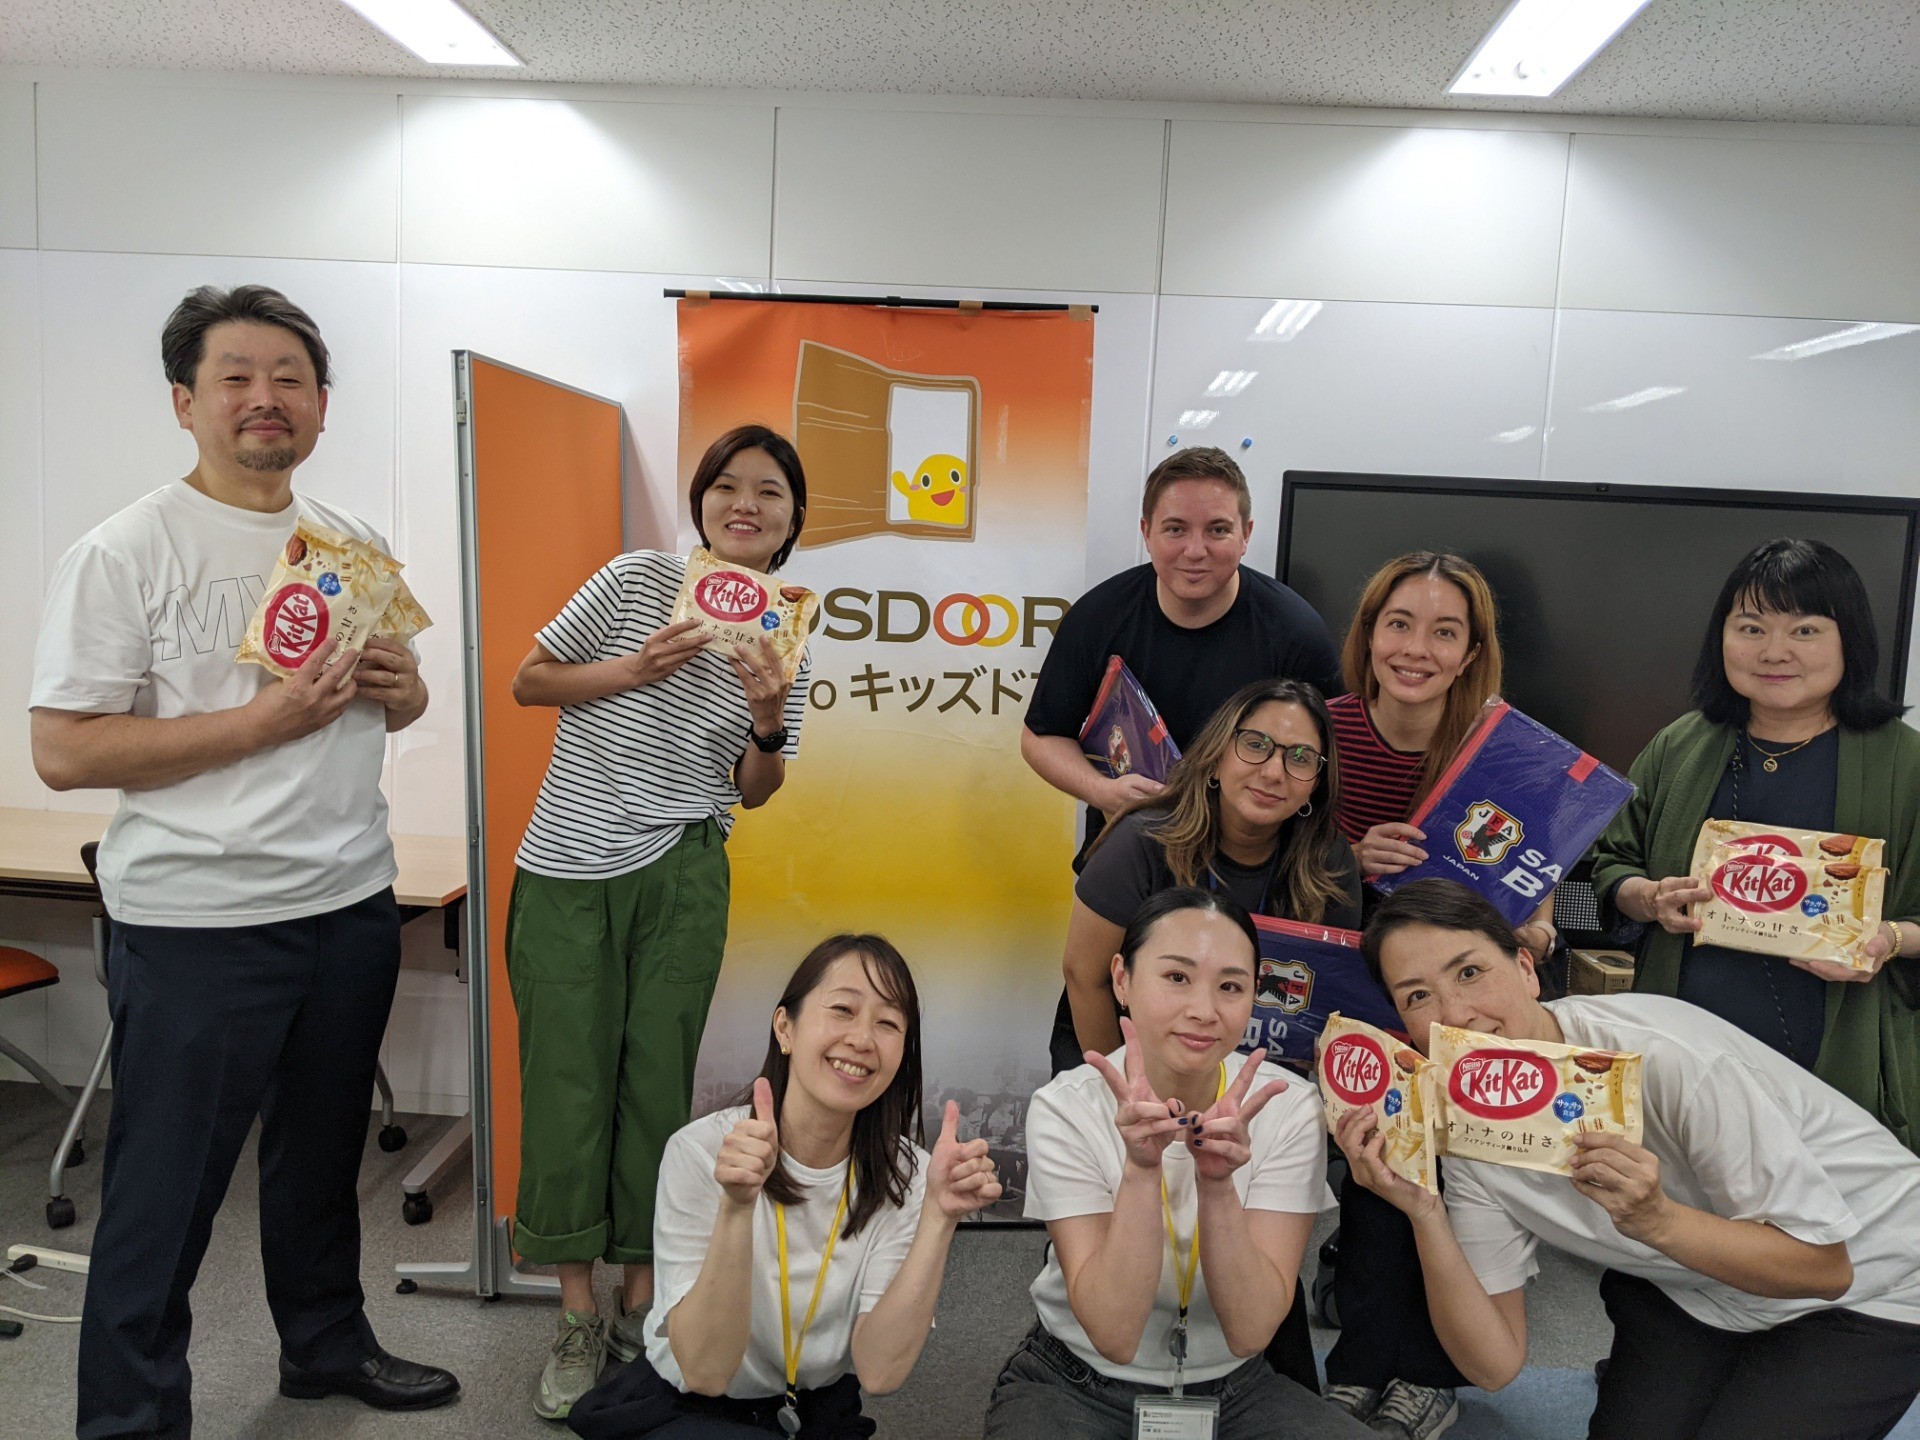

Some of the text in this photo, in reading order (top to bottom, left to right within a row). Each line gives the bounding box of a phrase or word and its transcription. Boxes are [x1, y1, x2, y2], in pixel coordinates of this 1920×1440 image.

[709, 581, 758, 611] KitKat
[276, 594, 317, 654] KitKat
[808, 587, 1072, 648] SDOOR
[850, 663, 1041, 715] キッズド
[1478, 809, 1513, 837] JFA
[1443, 854, 1480, 881] JAPAN
[1518, 848, 1564, 883] SA
[1730, 866, 1793, 902] KitKat
[1336, 1048, 1379, 1091] KitKat
[1469, 1060, 1540, 1105] KitKat
